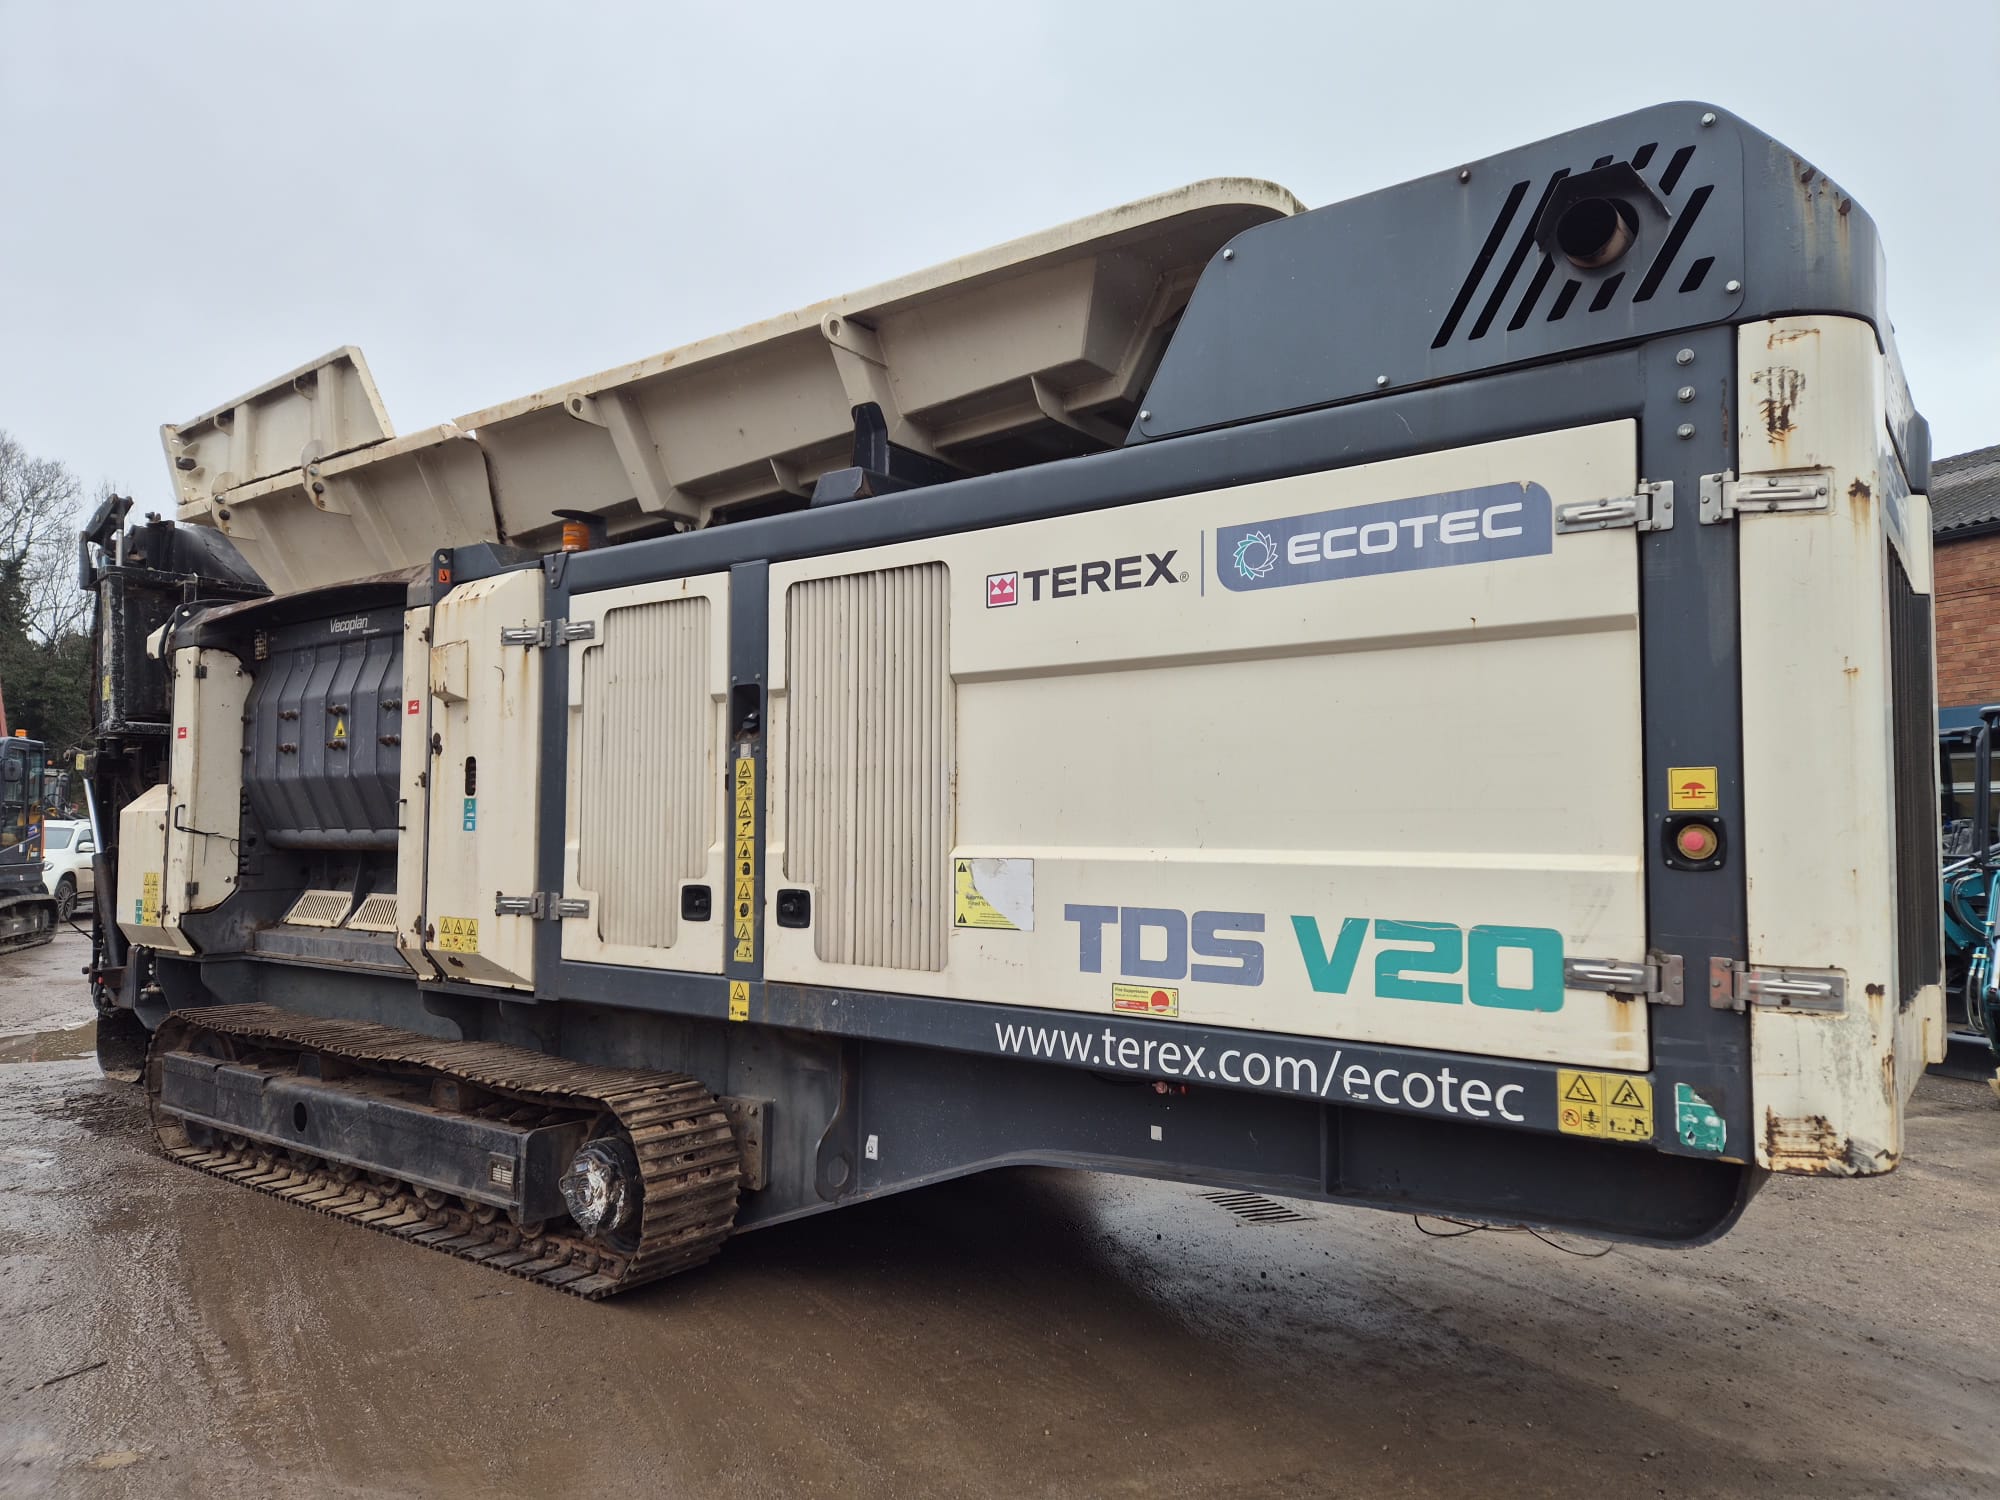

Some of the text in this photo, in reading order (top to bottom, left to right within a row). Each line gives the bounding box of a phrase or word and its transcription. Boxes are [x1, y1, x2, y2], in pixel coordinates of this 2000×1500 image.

[1287, 502, 1523, 566] ECOTEC
[329, 615, 368, 635] Vecoplan
[1064, 903, 1565, 1013] TDS V20
[994, 1022, 1526, 1123] www.terex.com/ecotec
